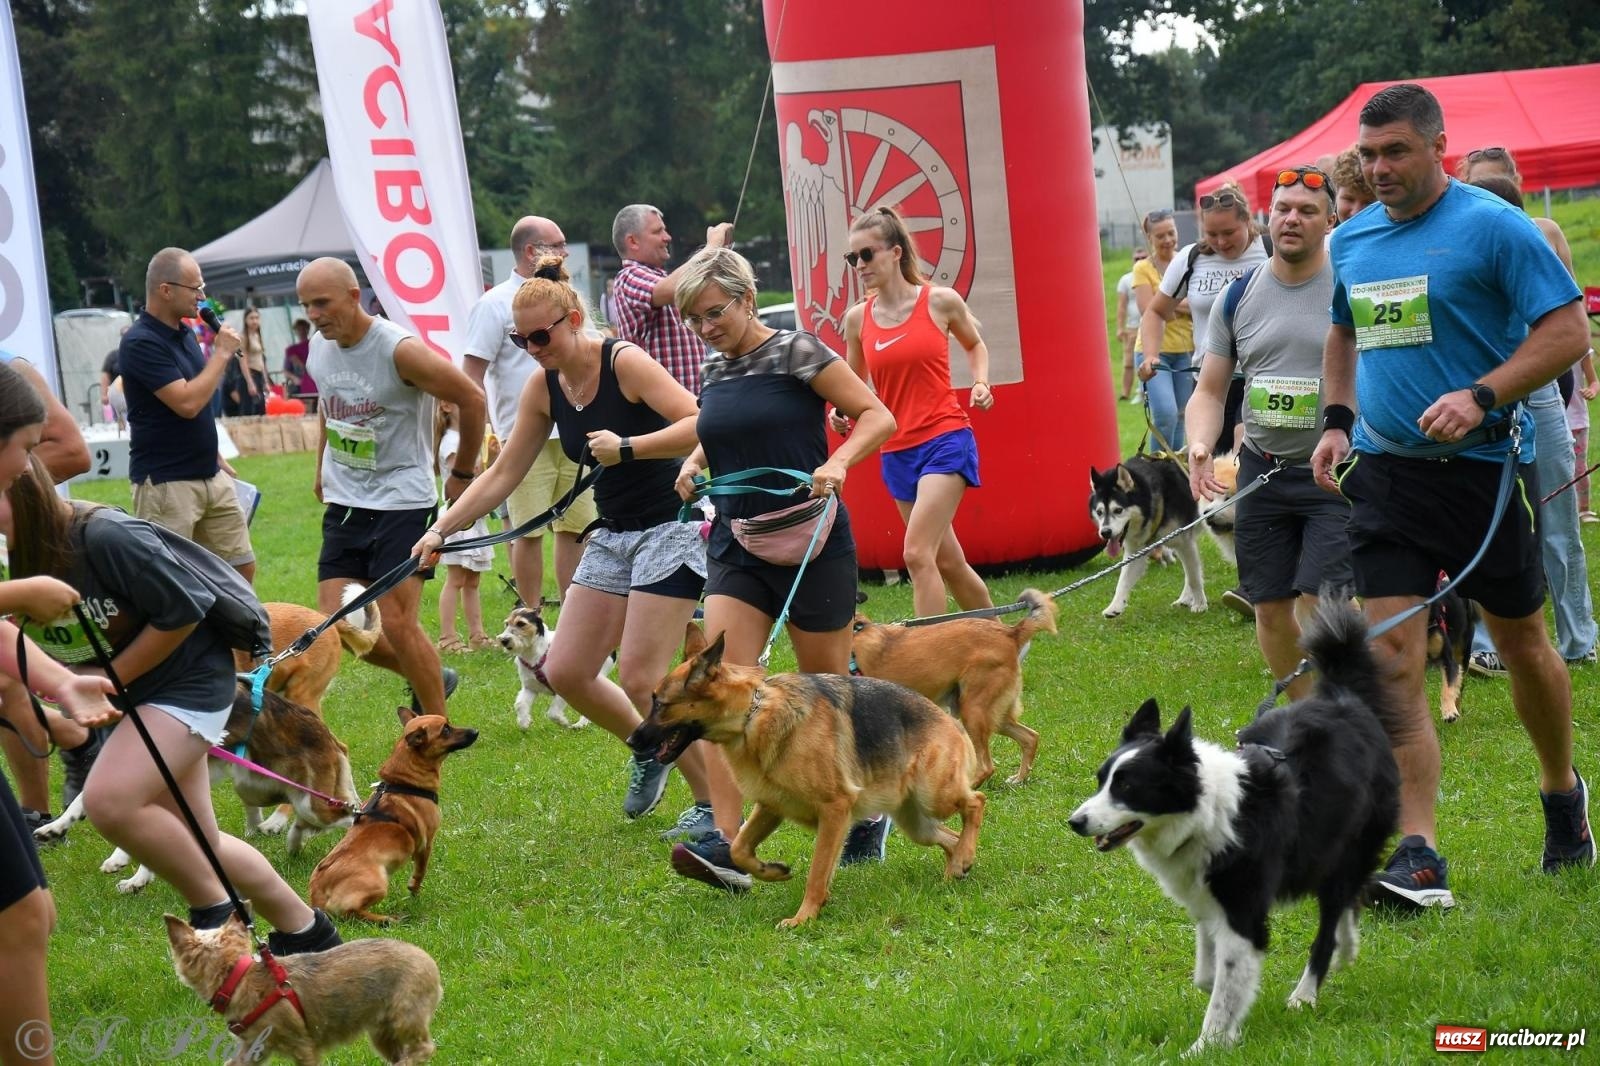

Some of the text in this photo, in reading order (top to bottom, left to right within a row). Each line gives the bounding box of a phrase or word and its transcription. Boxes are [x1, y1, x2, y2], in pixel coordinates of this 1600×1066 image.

[1198, 276, 1238, 292] BEA
[1382, 279, 1426, 290] DOGTREKKING
[1374, 301, 1402, 325] 25
[1268, 394, 1294, 411] 59
[341, 438, 359, 454] 17
[96, 449, 111, 475] 2
[43, 626, 73, 645] 40
